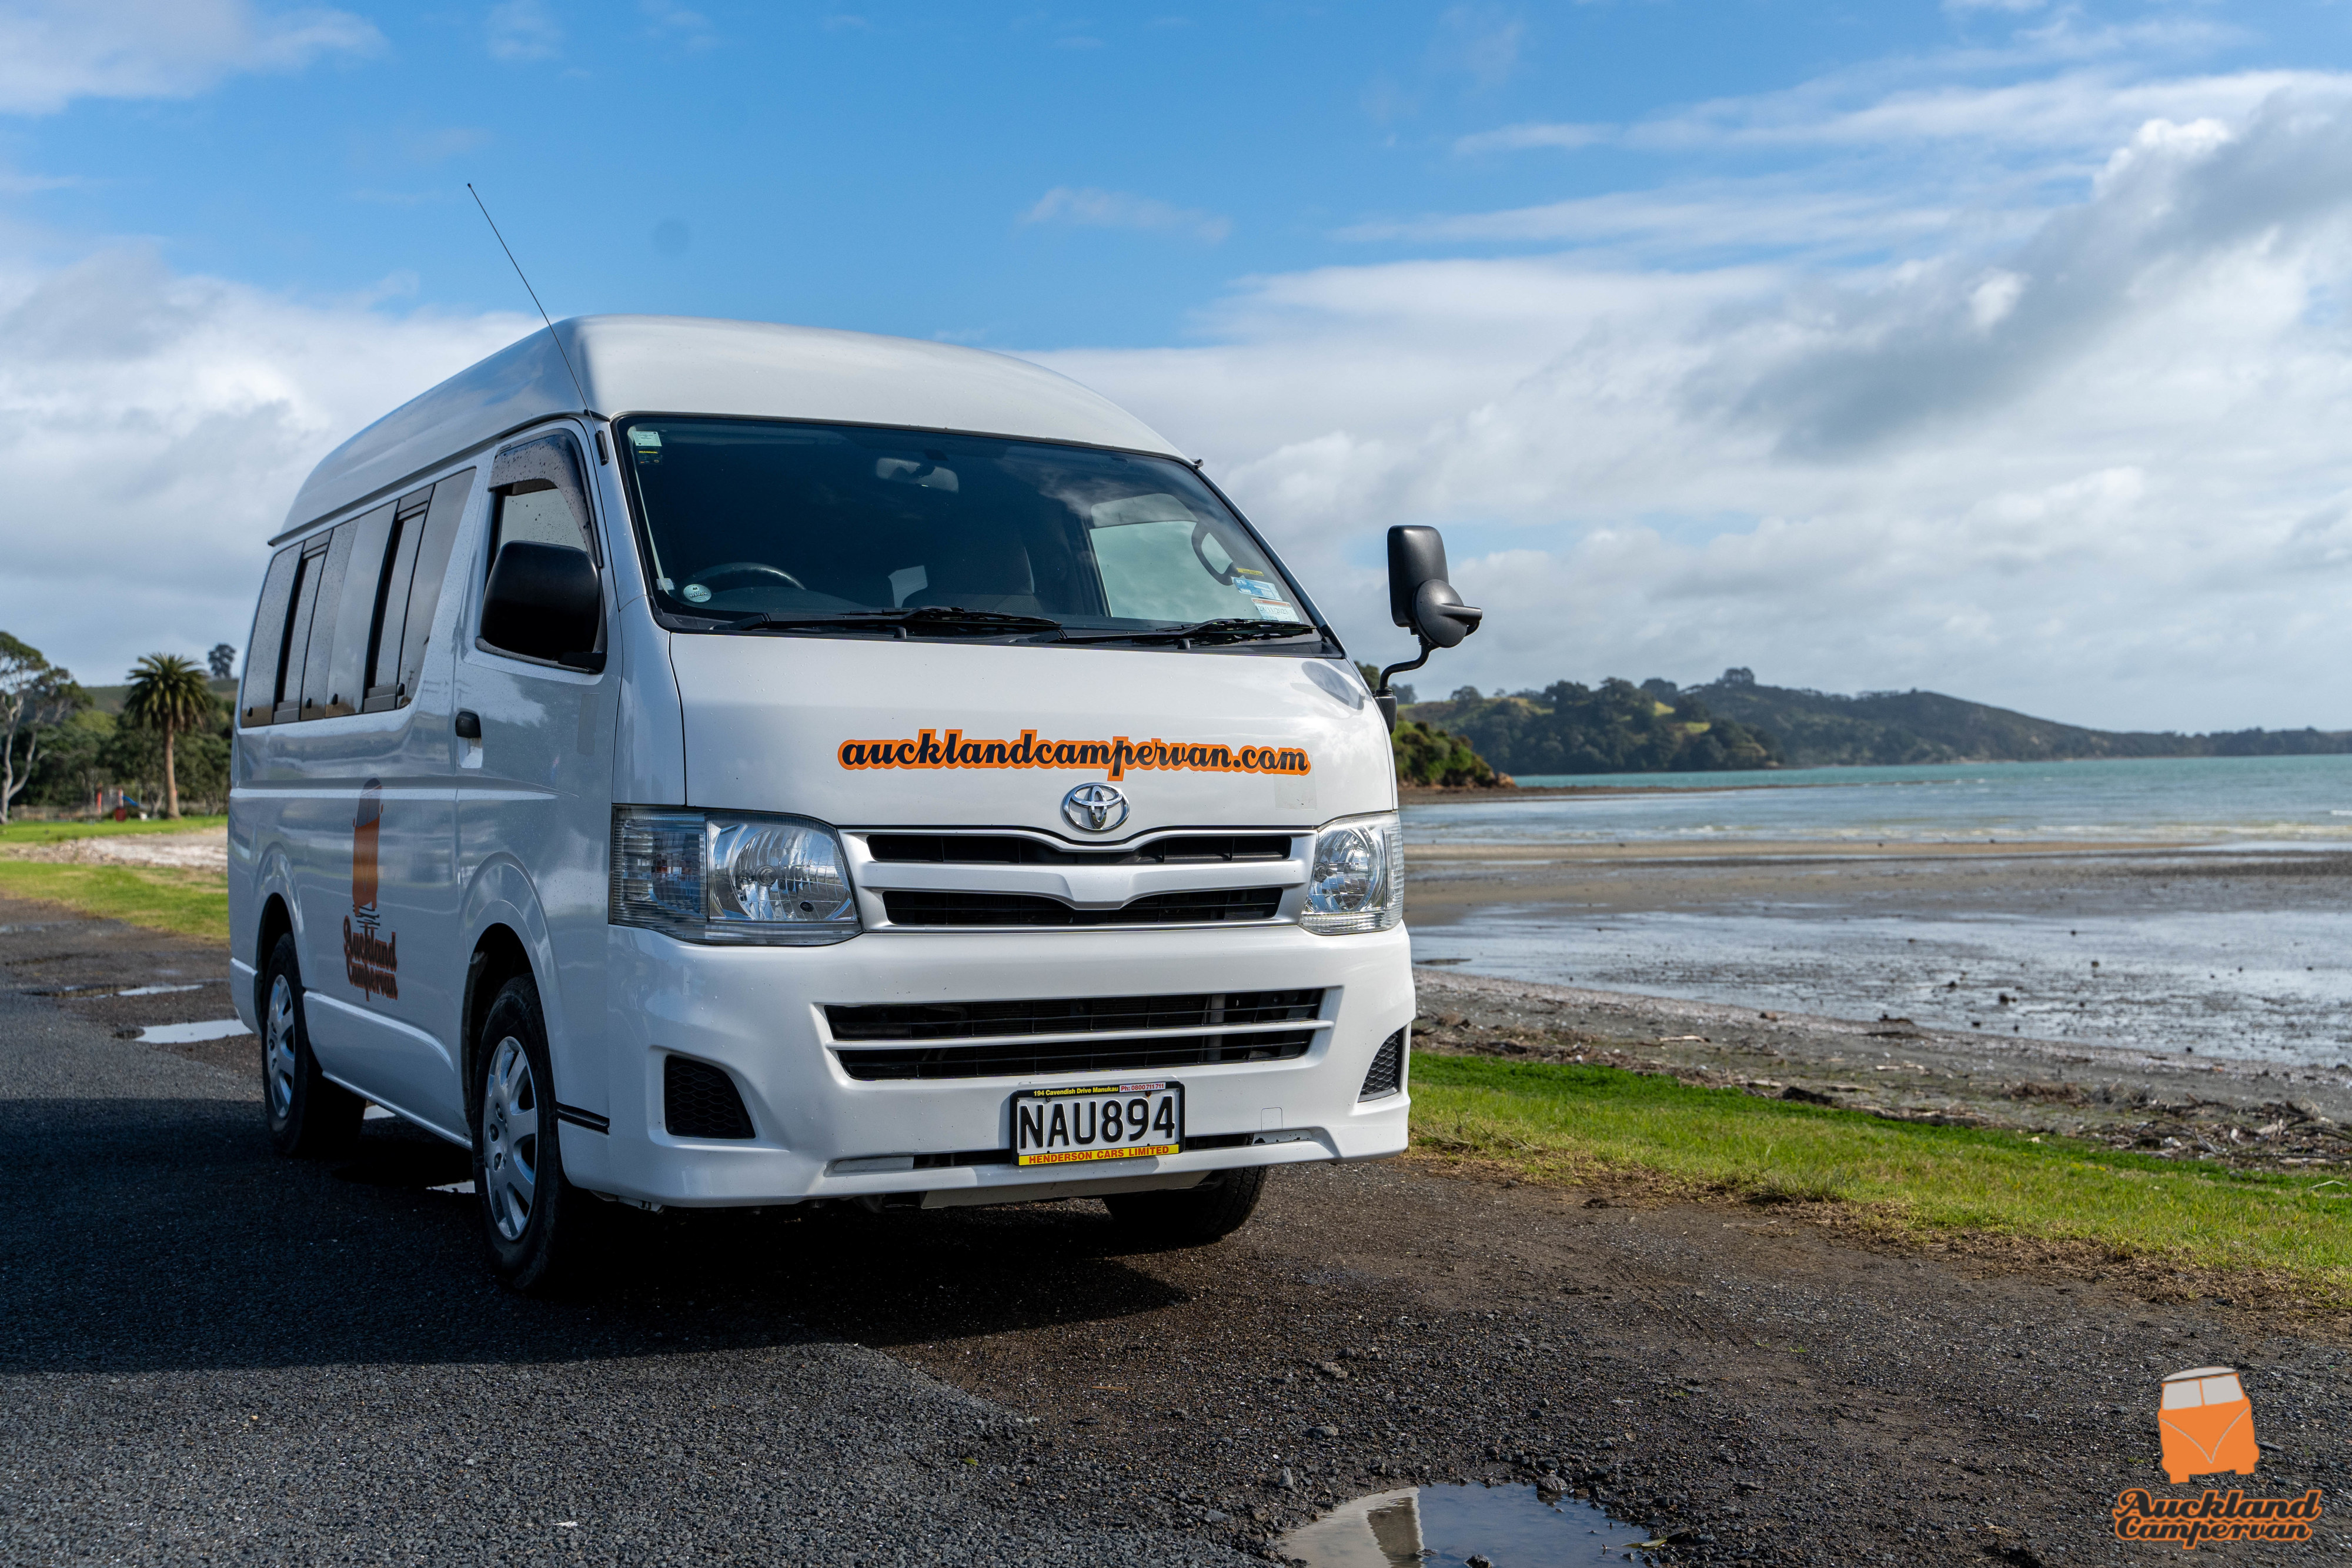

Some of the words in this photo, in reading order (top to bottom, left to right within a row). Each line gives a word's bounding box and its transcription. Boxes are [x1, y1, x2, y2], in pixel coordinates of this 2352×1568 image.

[838, 730, 1311, 781] aucklandcampervan.com
[343, 915, 397, 972] Auckland
[346, 950, 398, 1001] Campervan
[1020, 1096, 1175, 1149] NAU894
[1028, 1149, 1093, 1164] HENDERSON
[1097, 1148, 1124, 1159] CARS
[1128, 1146, 1169, 1156] LIMITED
